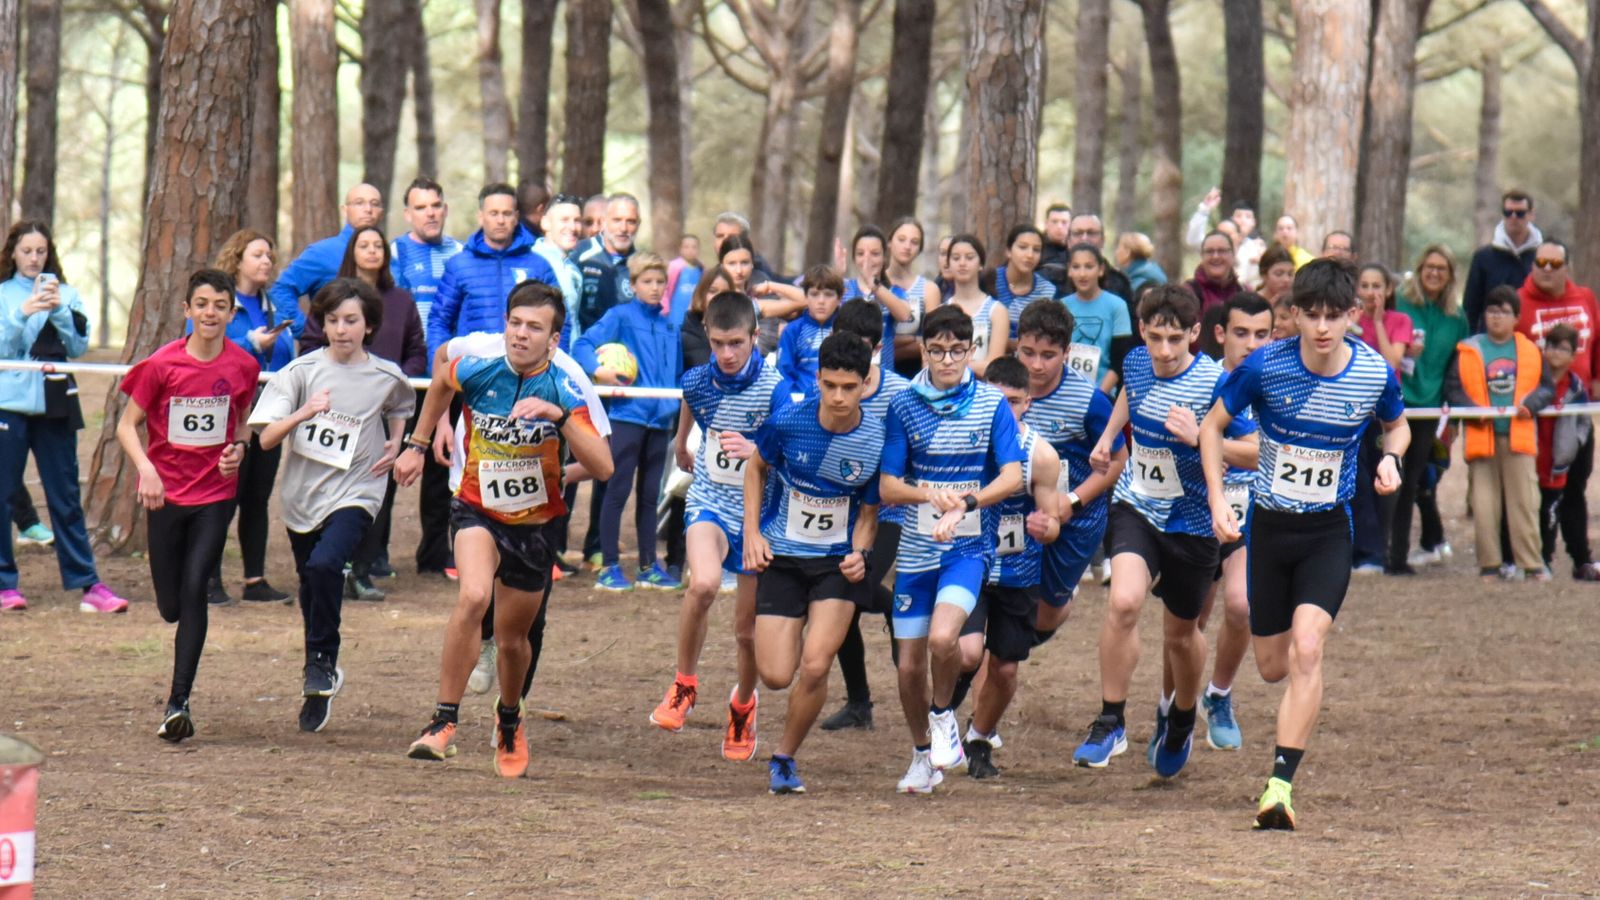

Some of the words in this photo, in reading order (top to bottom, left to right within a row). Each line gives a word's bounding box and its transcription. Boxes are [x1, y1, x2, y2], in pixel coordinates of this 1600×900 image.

[1071, 357, 1093, 373] 66
[183, 414, 215, 432] 63
[304, 423, 350, 452] 161
[479, 428, 510, 443] TEAM
[1137, 461, 1165, 483] 74
[1279, 462, 1334, 487] 218
[487, 476, 539, 499] 168
[801, 510, 834, 531] 75
